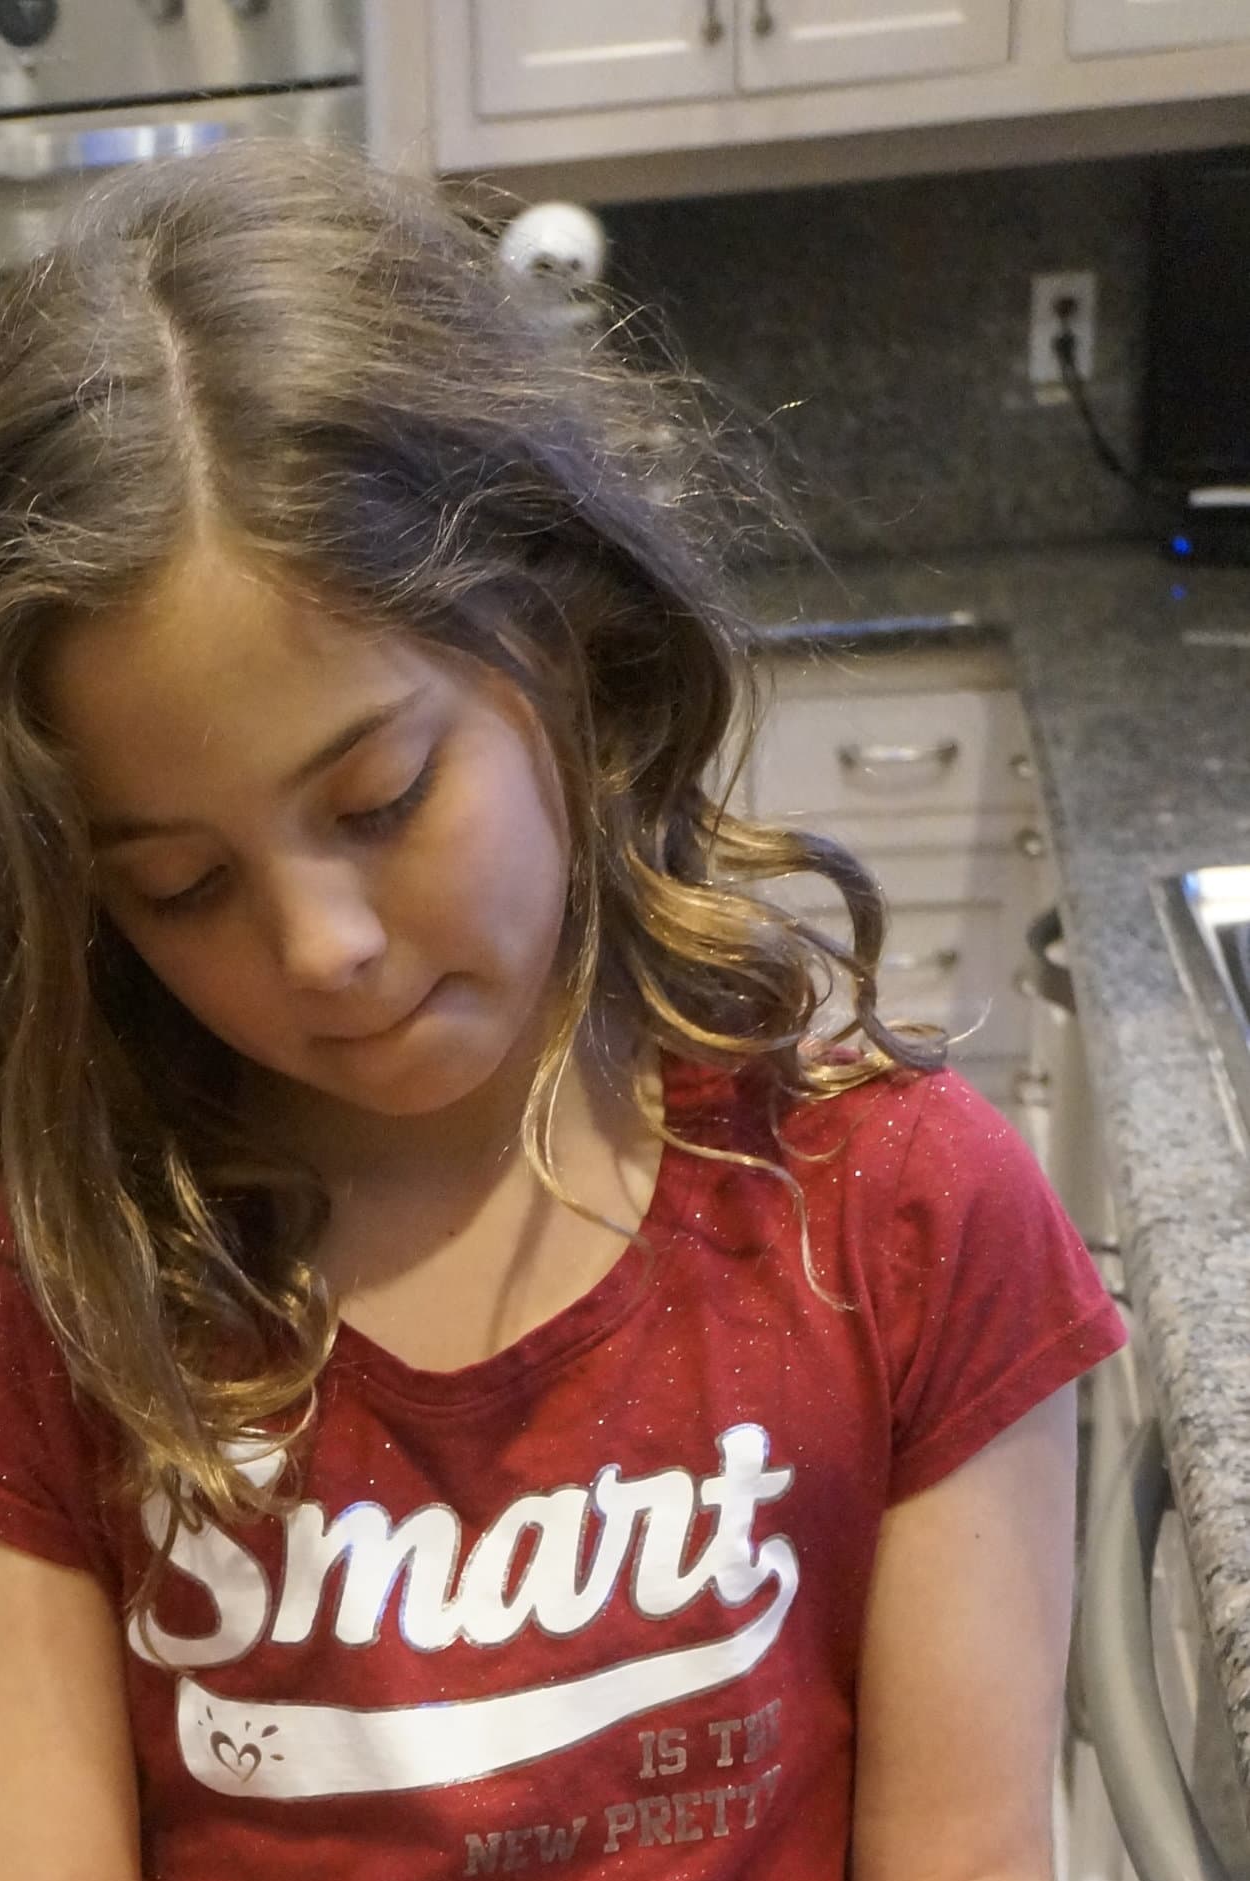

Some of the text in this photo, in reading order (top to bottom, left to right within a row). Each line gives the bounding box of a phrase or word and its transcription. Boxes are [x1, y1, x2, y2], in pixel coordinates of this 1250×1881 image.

[127, 1422, 801, 1669] Smart
[638, 1727, 687, 1780] IS
[462, 1816, 587, 1878] NEW
